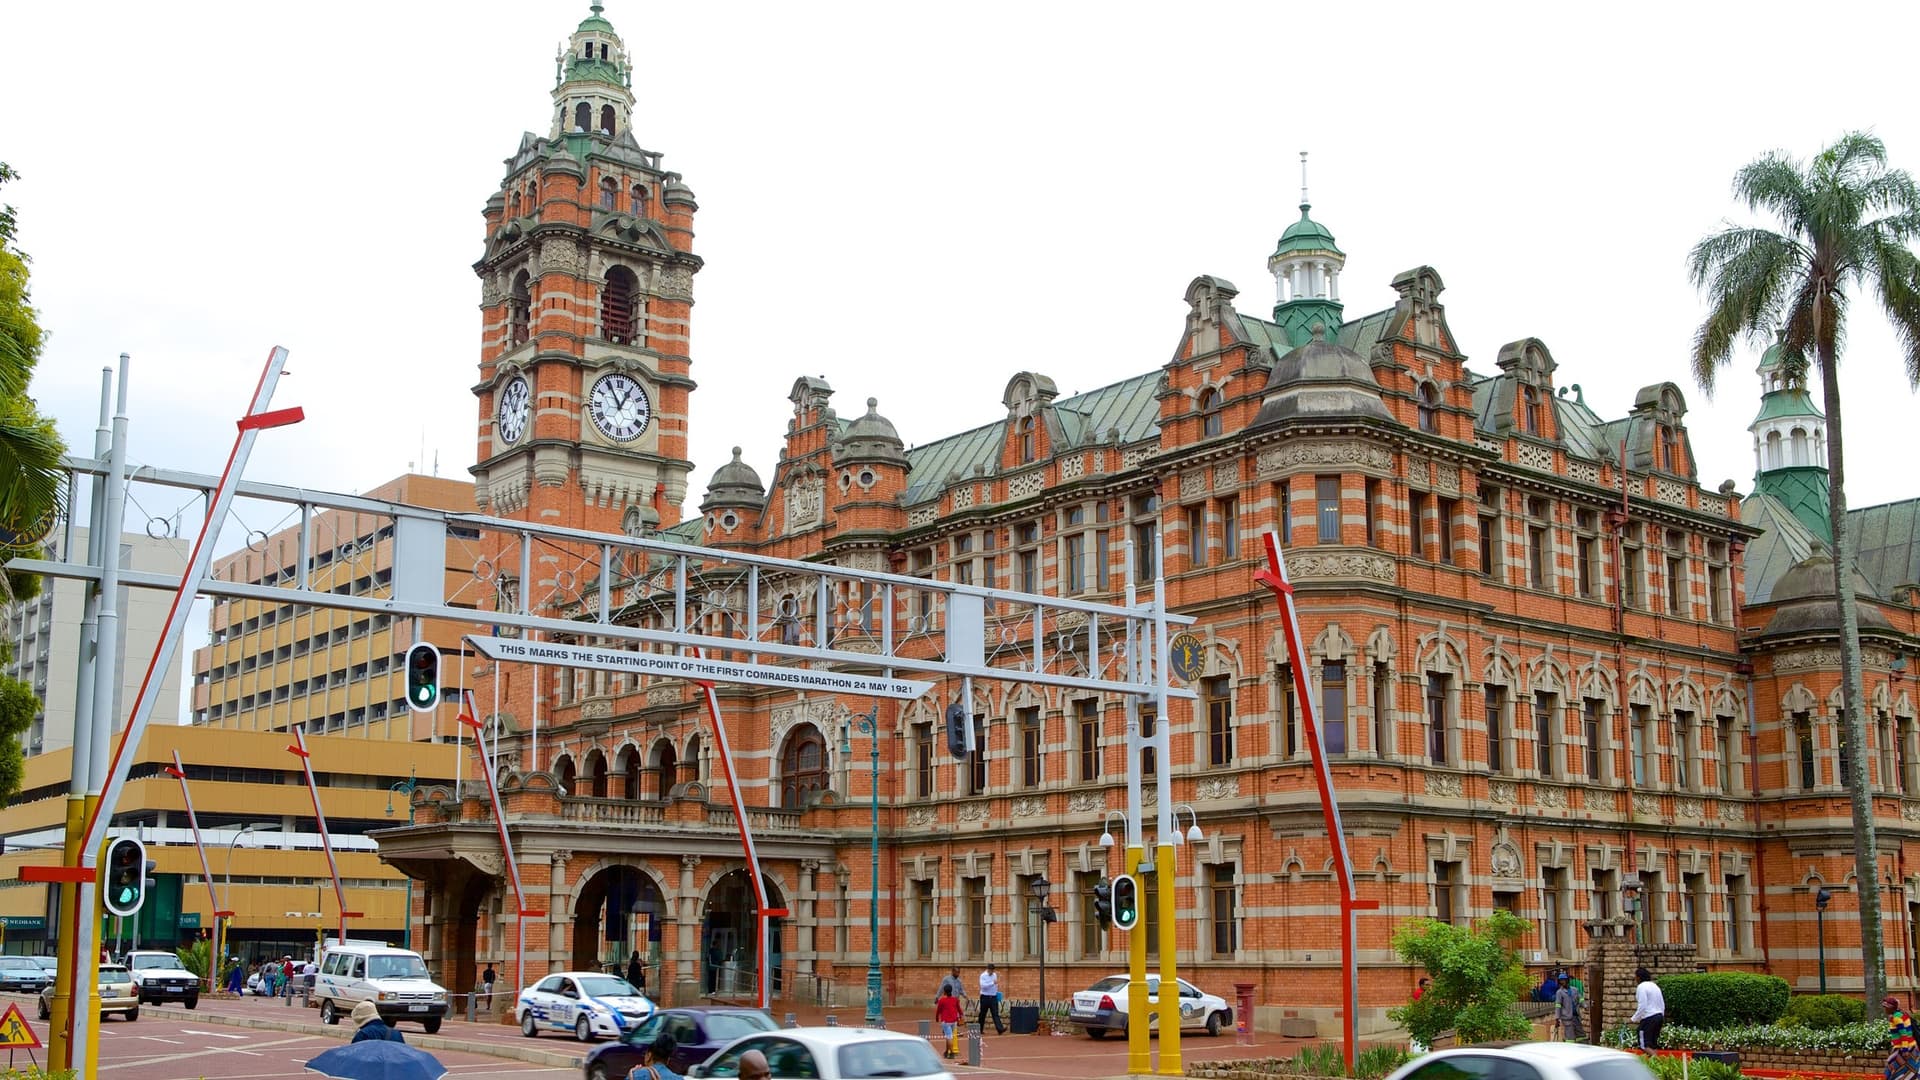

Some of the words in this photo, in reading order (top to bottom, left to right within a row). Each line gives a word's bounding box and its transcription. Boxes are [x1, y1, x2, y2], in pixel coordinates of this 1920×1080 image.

[499, 644, 526, 655] THIS
[529, 647, 569, 659] MARKS
[571, 651, 593, 662] THE
[596, 654, 648, 667] STARTING
[648, 659, 680, 669] POINT
[680, 662, 695, 671] OF
[695, 664, 716, 674] THE
[716, 666, 745, 677] FIRST
[745, 670, 800, 683] COMRADES
[800, 676, 852, 688] MARATHON
[853, 681, 866, 689] 24
[868, 683, 888, 692] MAY
[891, 685, 913, 694] 1921
